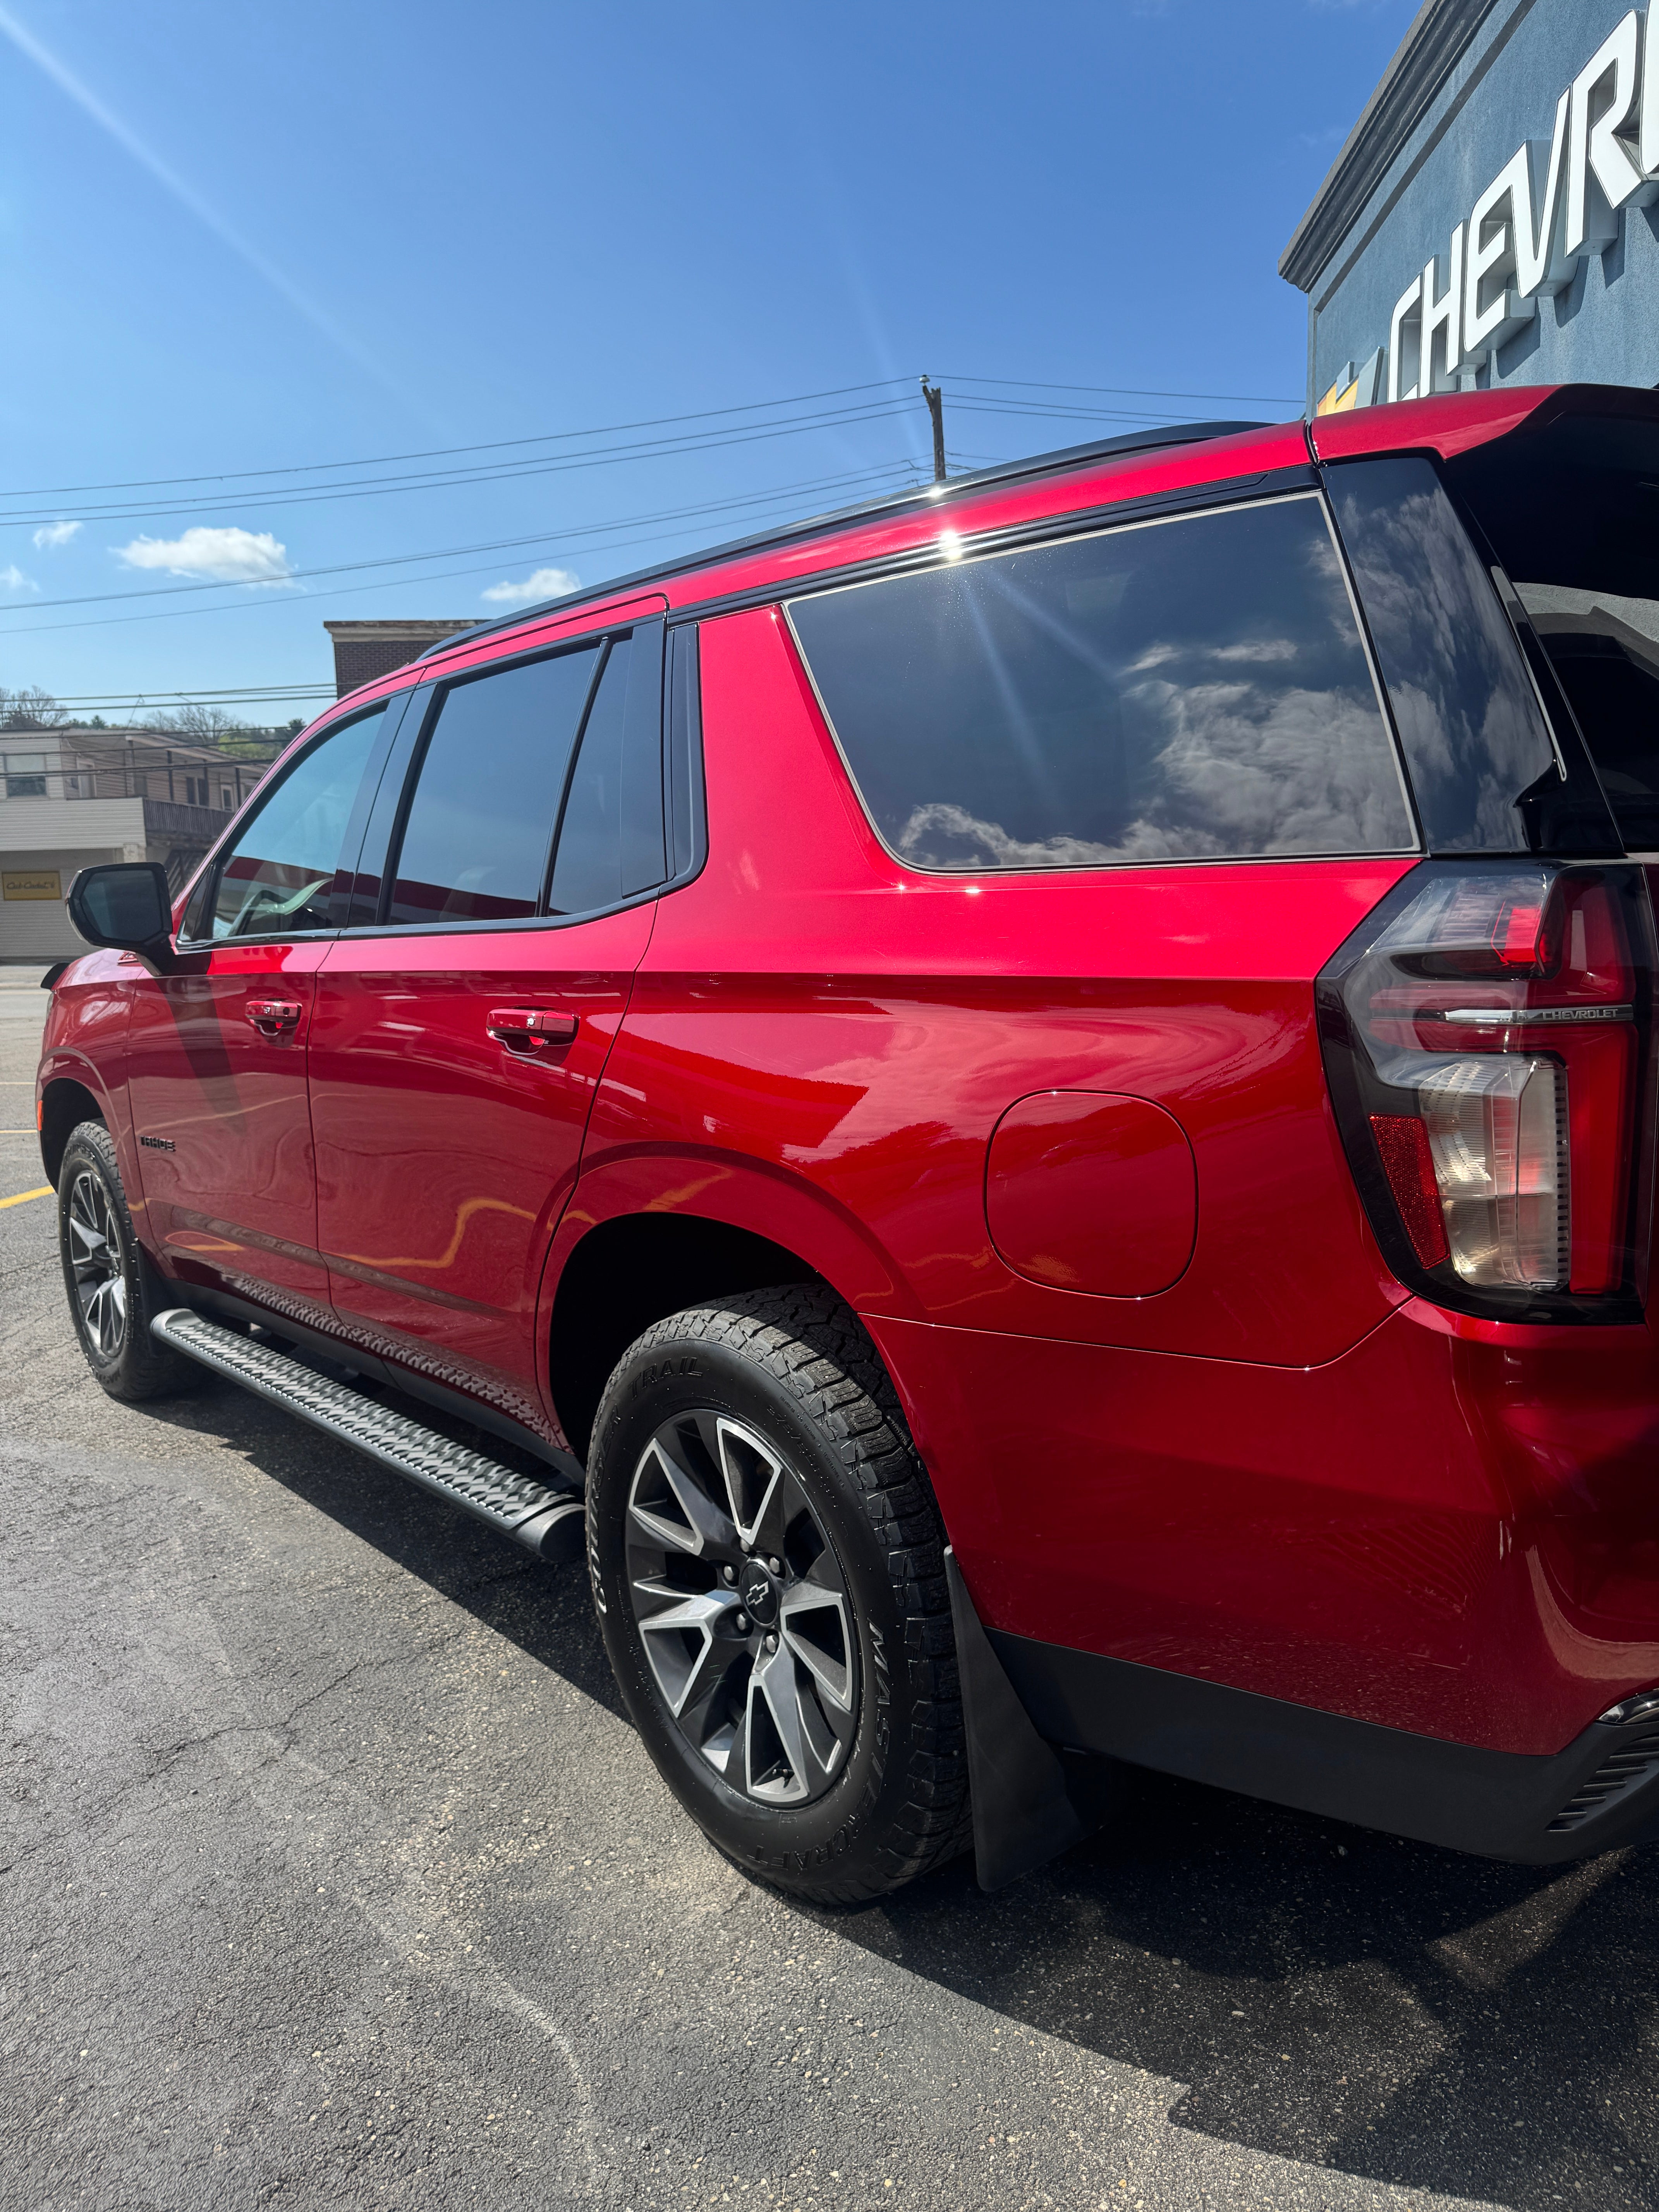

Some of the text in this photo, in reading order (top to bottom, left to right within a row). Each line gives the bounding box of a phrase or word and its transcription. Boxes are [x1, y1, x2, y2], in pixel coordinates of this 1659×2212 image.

[1388, 0, 1659, 403] CHEVR
[1542, 1009, 1618, 1020] CHEVROLET
[139, 1135, 176, 1152] TAHOE
[627, 1357, 703, 1400] TRAIL
[747, 1617, 890, 1870] MASTERCRAFT
